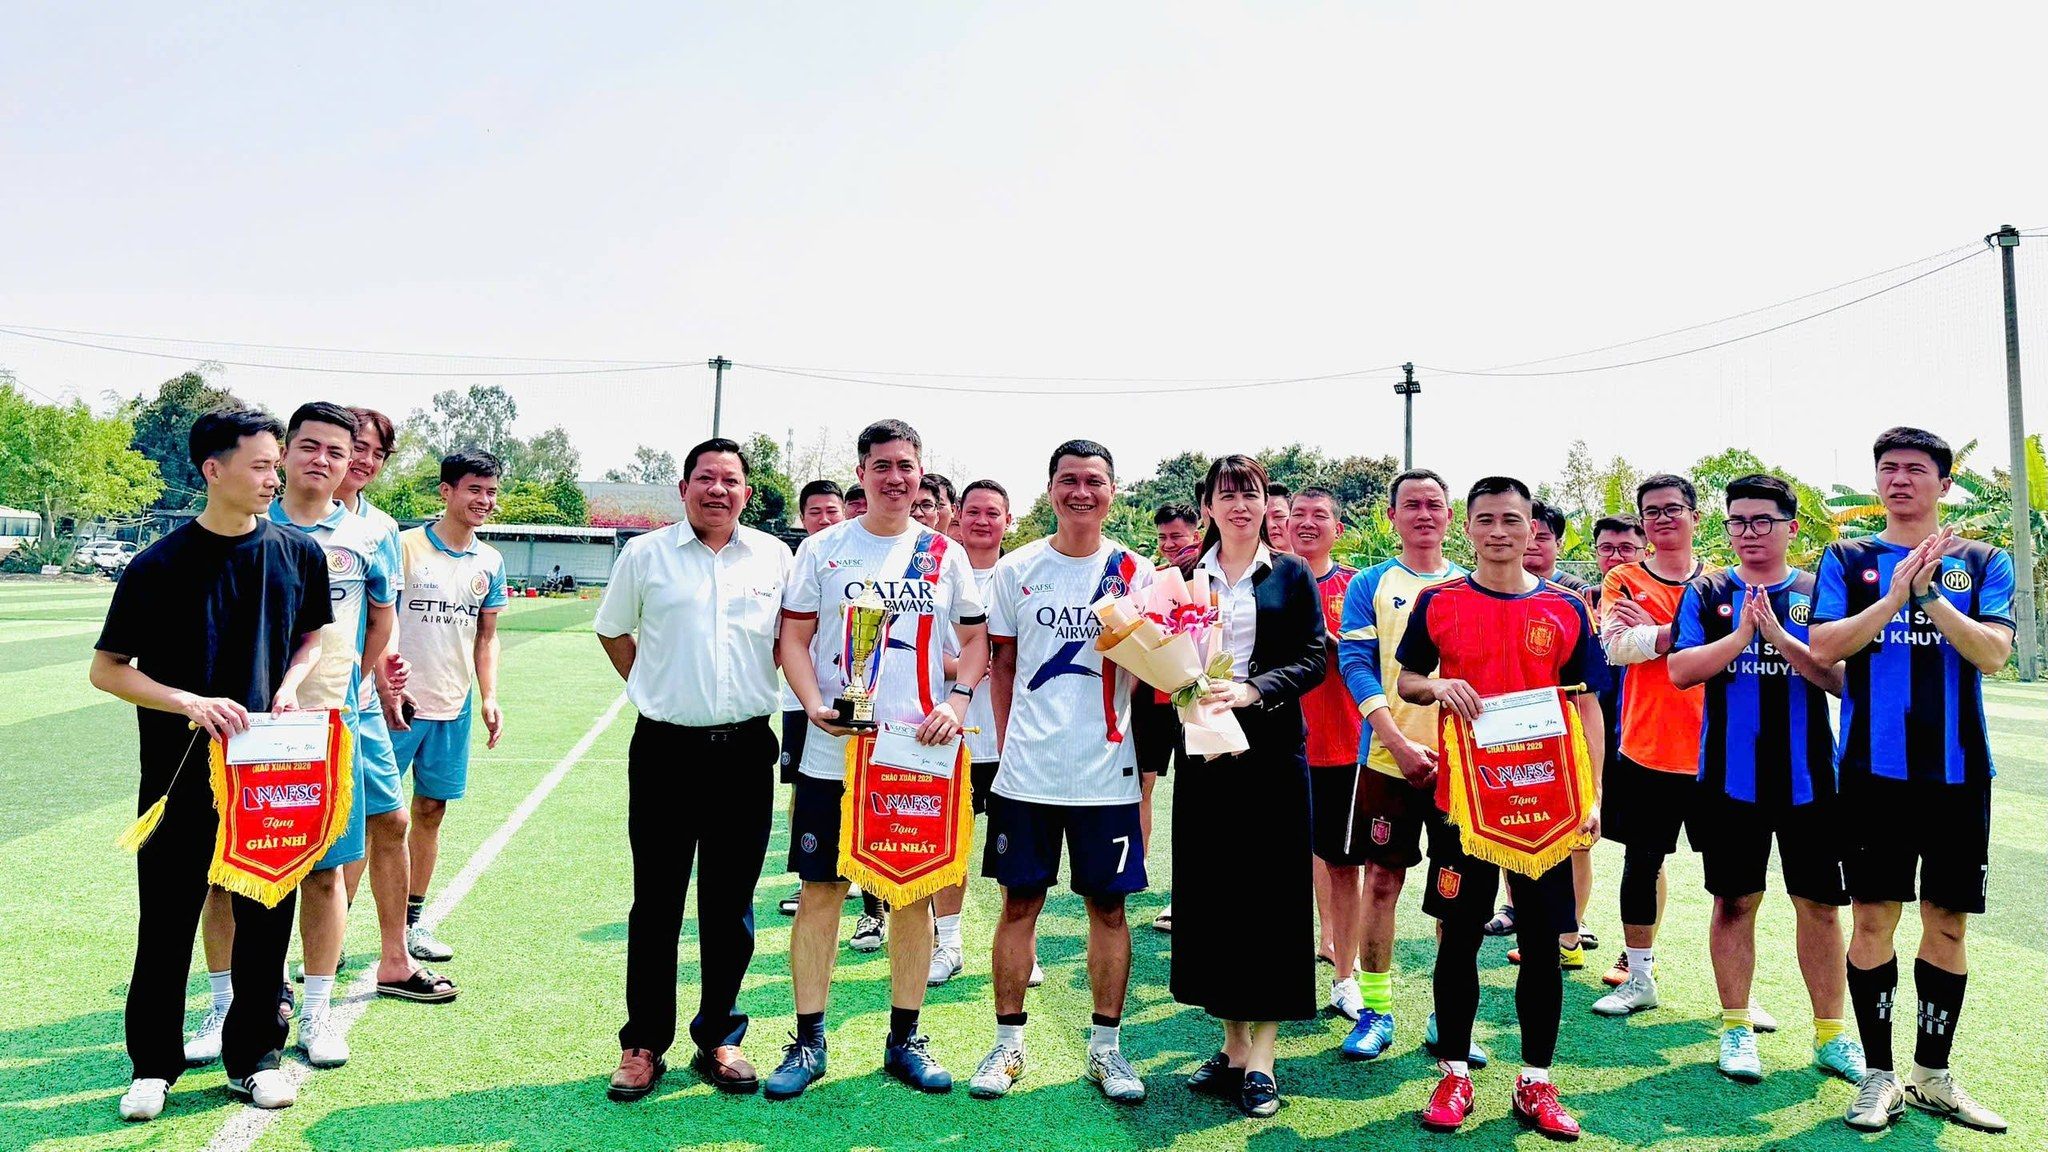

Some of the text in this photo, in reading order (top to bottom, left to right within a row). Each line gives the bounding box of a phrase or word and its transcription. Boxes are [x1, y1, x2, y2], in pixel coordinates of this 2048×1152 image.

[408, 599, 479, 617] ETIHAD
[883, 600, 934, 613] RWAYS
[1036, 606, 1103, 629] QATA
[1890, 610, 1910, 624] AI
[1054, 626, 1105, 639] AIRWA
[1890, 630, 1951, 646] KHUY
[1741, 642, 1759, 655] AI
[1498, 762, 1555, 782] NAFSC
[257, 784, 321, 802] NAFSC
[887, 794, 942, 812] NAFSC
[1500, 810, 1551, 826] GIẢI BA
[246, 834, 279, 850] GIẢI
[870, 838, 937, 854] GIẢI NHẤT
[1112, 835, 1130, 874] 7
